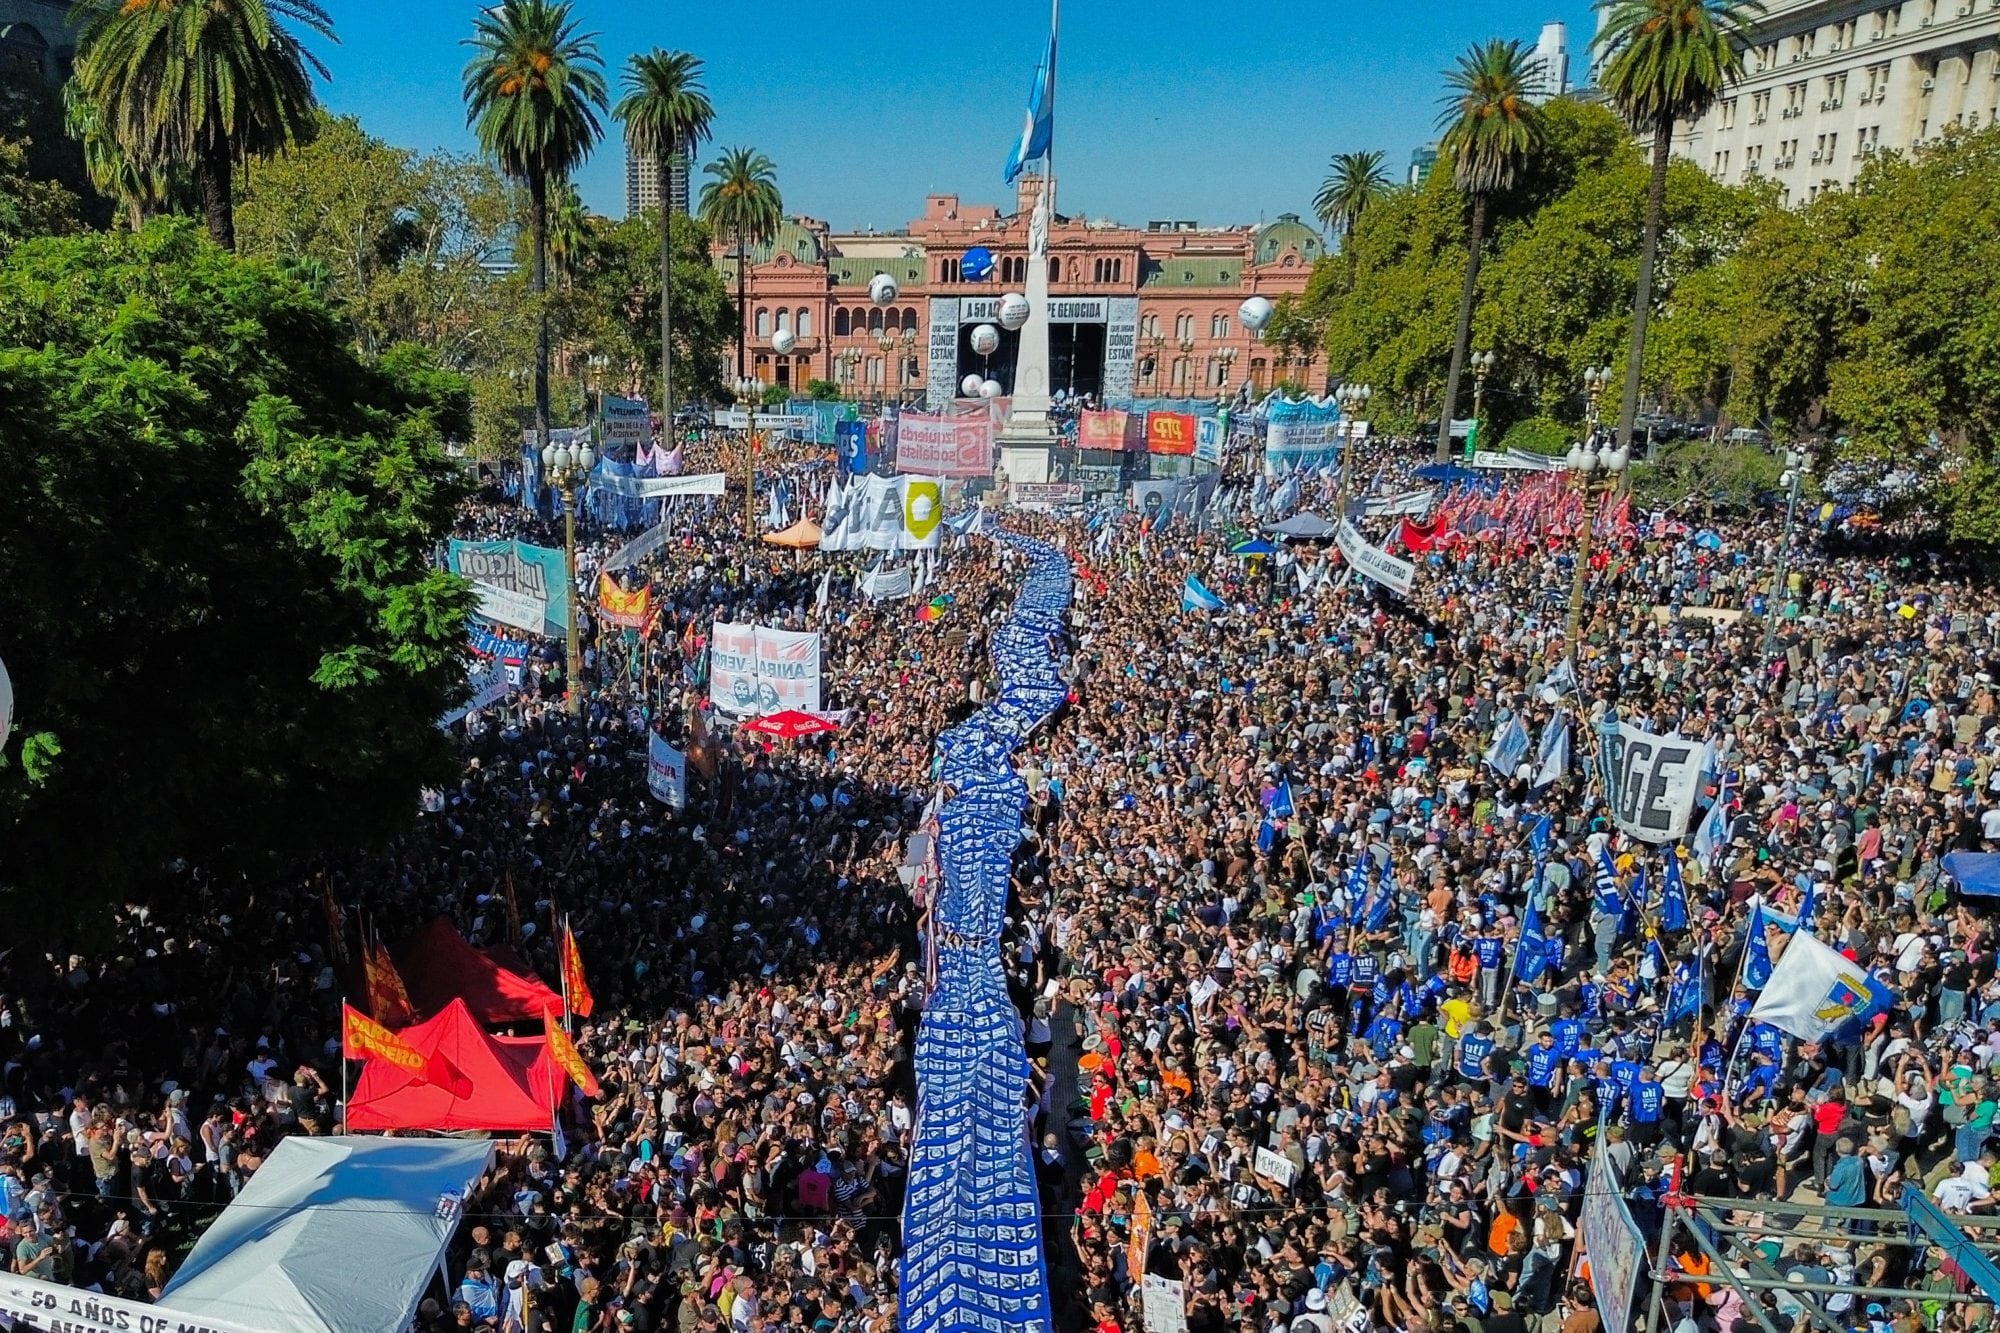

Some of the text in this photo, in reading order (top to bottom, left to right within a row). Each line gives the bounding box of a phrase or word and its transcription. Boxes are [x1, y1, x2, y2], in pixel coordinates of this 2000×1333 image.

[974, 303, 986, 318] 50
[1057, 302, 1101, 318] GENOCIDA
[931, 333, 955, 346] DÓNDE
[1109, 334, 1133, 347] DÓNDE
[930, 347, 955, 360] ESTÁN!
[1108, 347, 1133, 360] ESTÁN!
[349, 1033, 424, 1068] OBRERO
[1465, 1043, 1485, 1056] uti
[1257, 1152, 1287, 1181] MEMORIA
[30, 1290, 57, 1310] 50
[68, 1296, 130, 1329] AÑOS
[140, 1314, 169, 1333] DE
